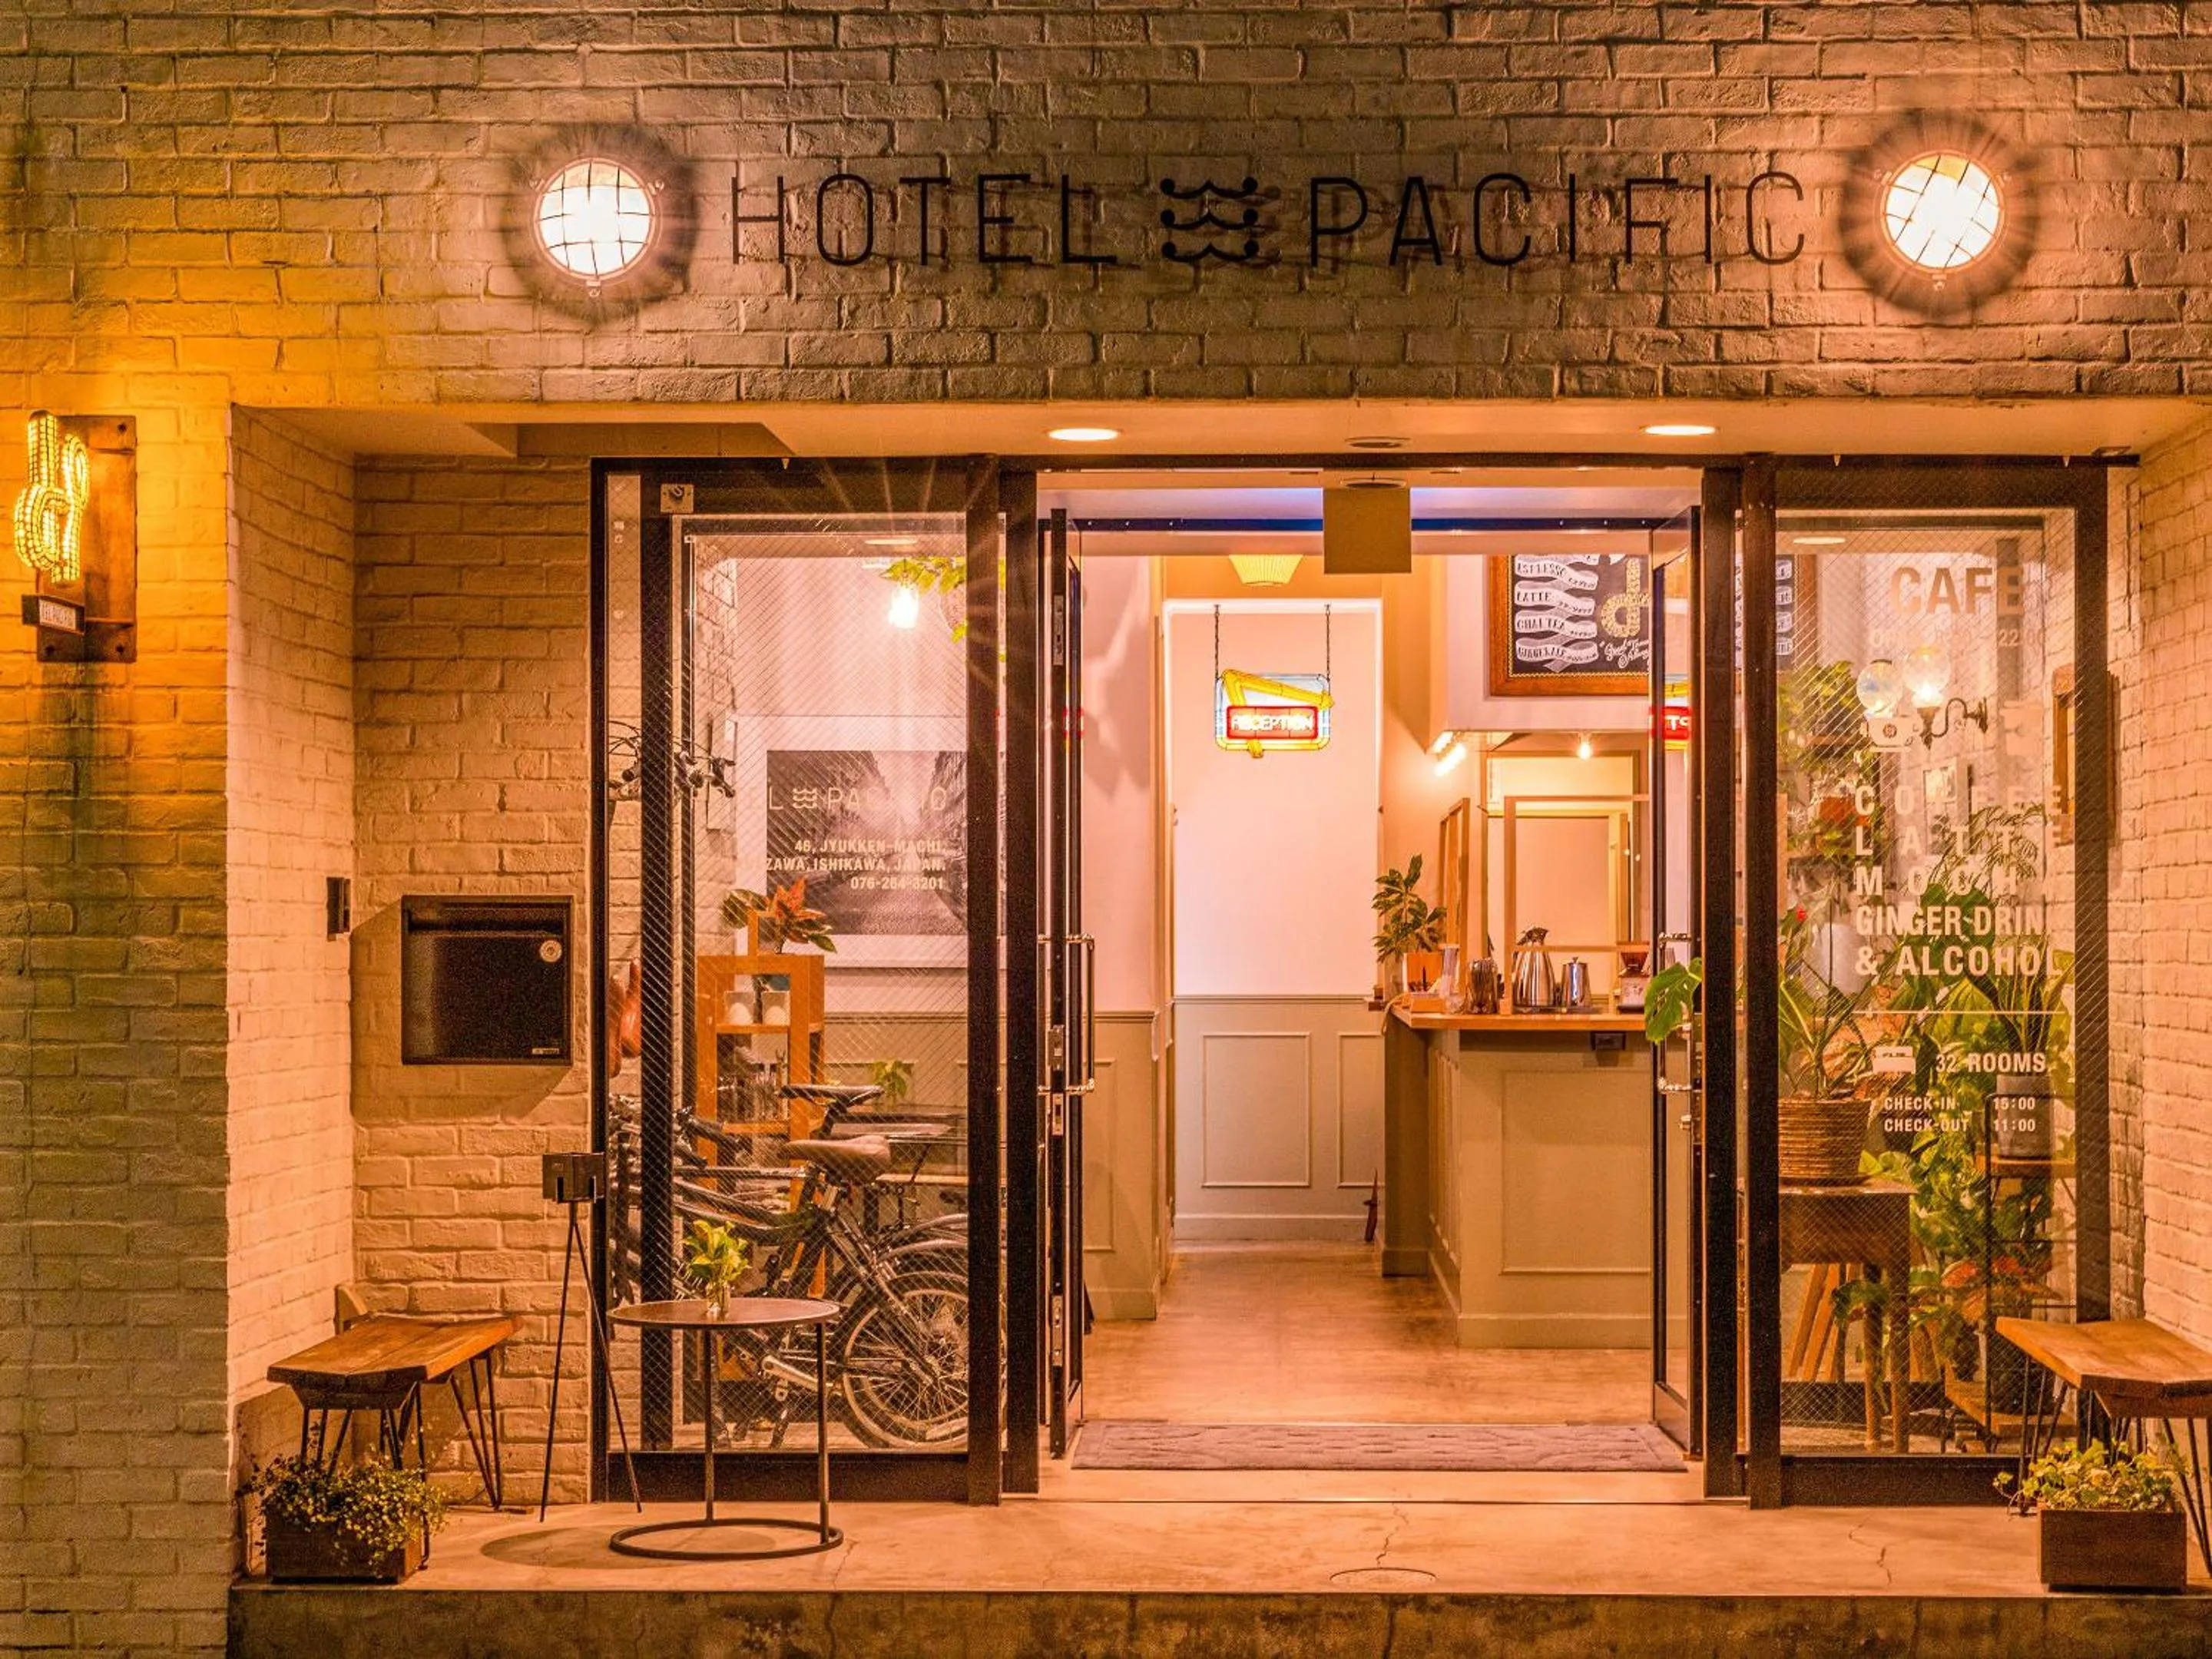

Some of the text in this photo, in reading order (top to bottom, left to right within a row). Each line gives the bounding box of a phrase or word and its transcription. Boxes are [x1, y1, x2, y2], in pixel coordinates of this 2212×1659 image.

[733, 172, 1806, 267] HOTEL PACIFIC
[1889, 566, 2025, 615] CAFE
[1856, 825, 2063, 856] LATTE
[1854, 866, 2065, 896] MOCH
[1974, 906, 2065, 936] DRIN
[1854, 945, 2064, 977] & ALCOHOL
[1935, 1052, 2048, 1074] 32 ROOMS
[1992, 1096, 2036, 1111] 15:00
[1883, 1118, 2036, 1133] CHECK-OUT 11:00
